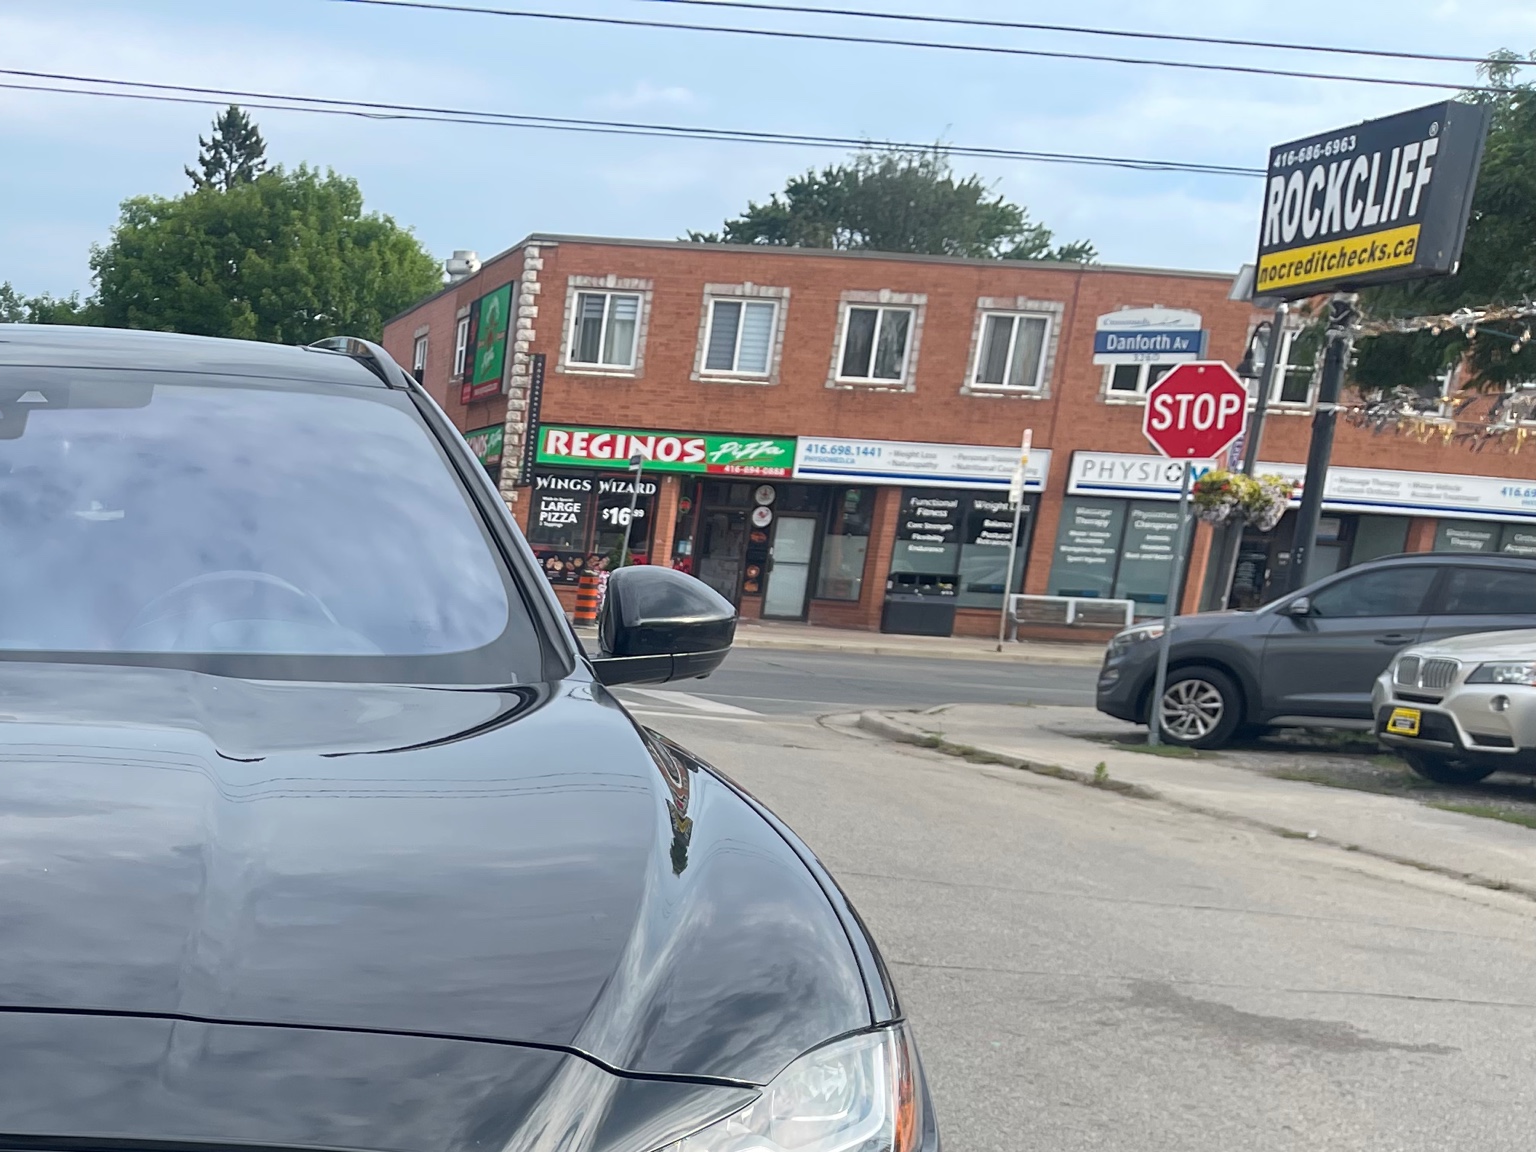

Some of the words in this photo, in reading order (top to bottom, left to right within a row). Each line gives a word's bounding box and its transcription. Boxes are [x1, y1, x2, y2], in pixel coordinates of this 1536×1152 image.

[1273, 135, 1357, 168] 416-686-6963
[1263, 137, 1439, 247] ROCKCLIFF
[1258, 237, 1416, 284] nocreditchecks.ca
[1106, 334, 1171, 350] Danforth
[1173, 336, 1190, 350] Av
[1151, 393, 1241, 431] STOP
[546, 430, 706, 464] REGINOS
[709, 441, 786, 462] Pizza
[806, 443, 882, 457] 416.698.1441
[536, 475, 592, 491] WINGS
[598, 478, 657, 494] WIZARD
[541, 501, 581, 512] LARGE
[1010, 502, 1031, 512] Lss
[539, 512, 578, 523] PIZZA
